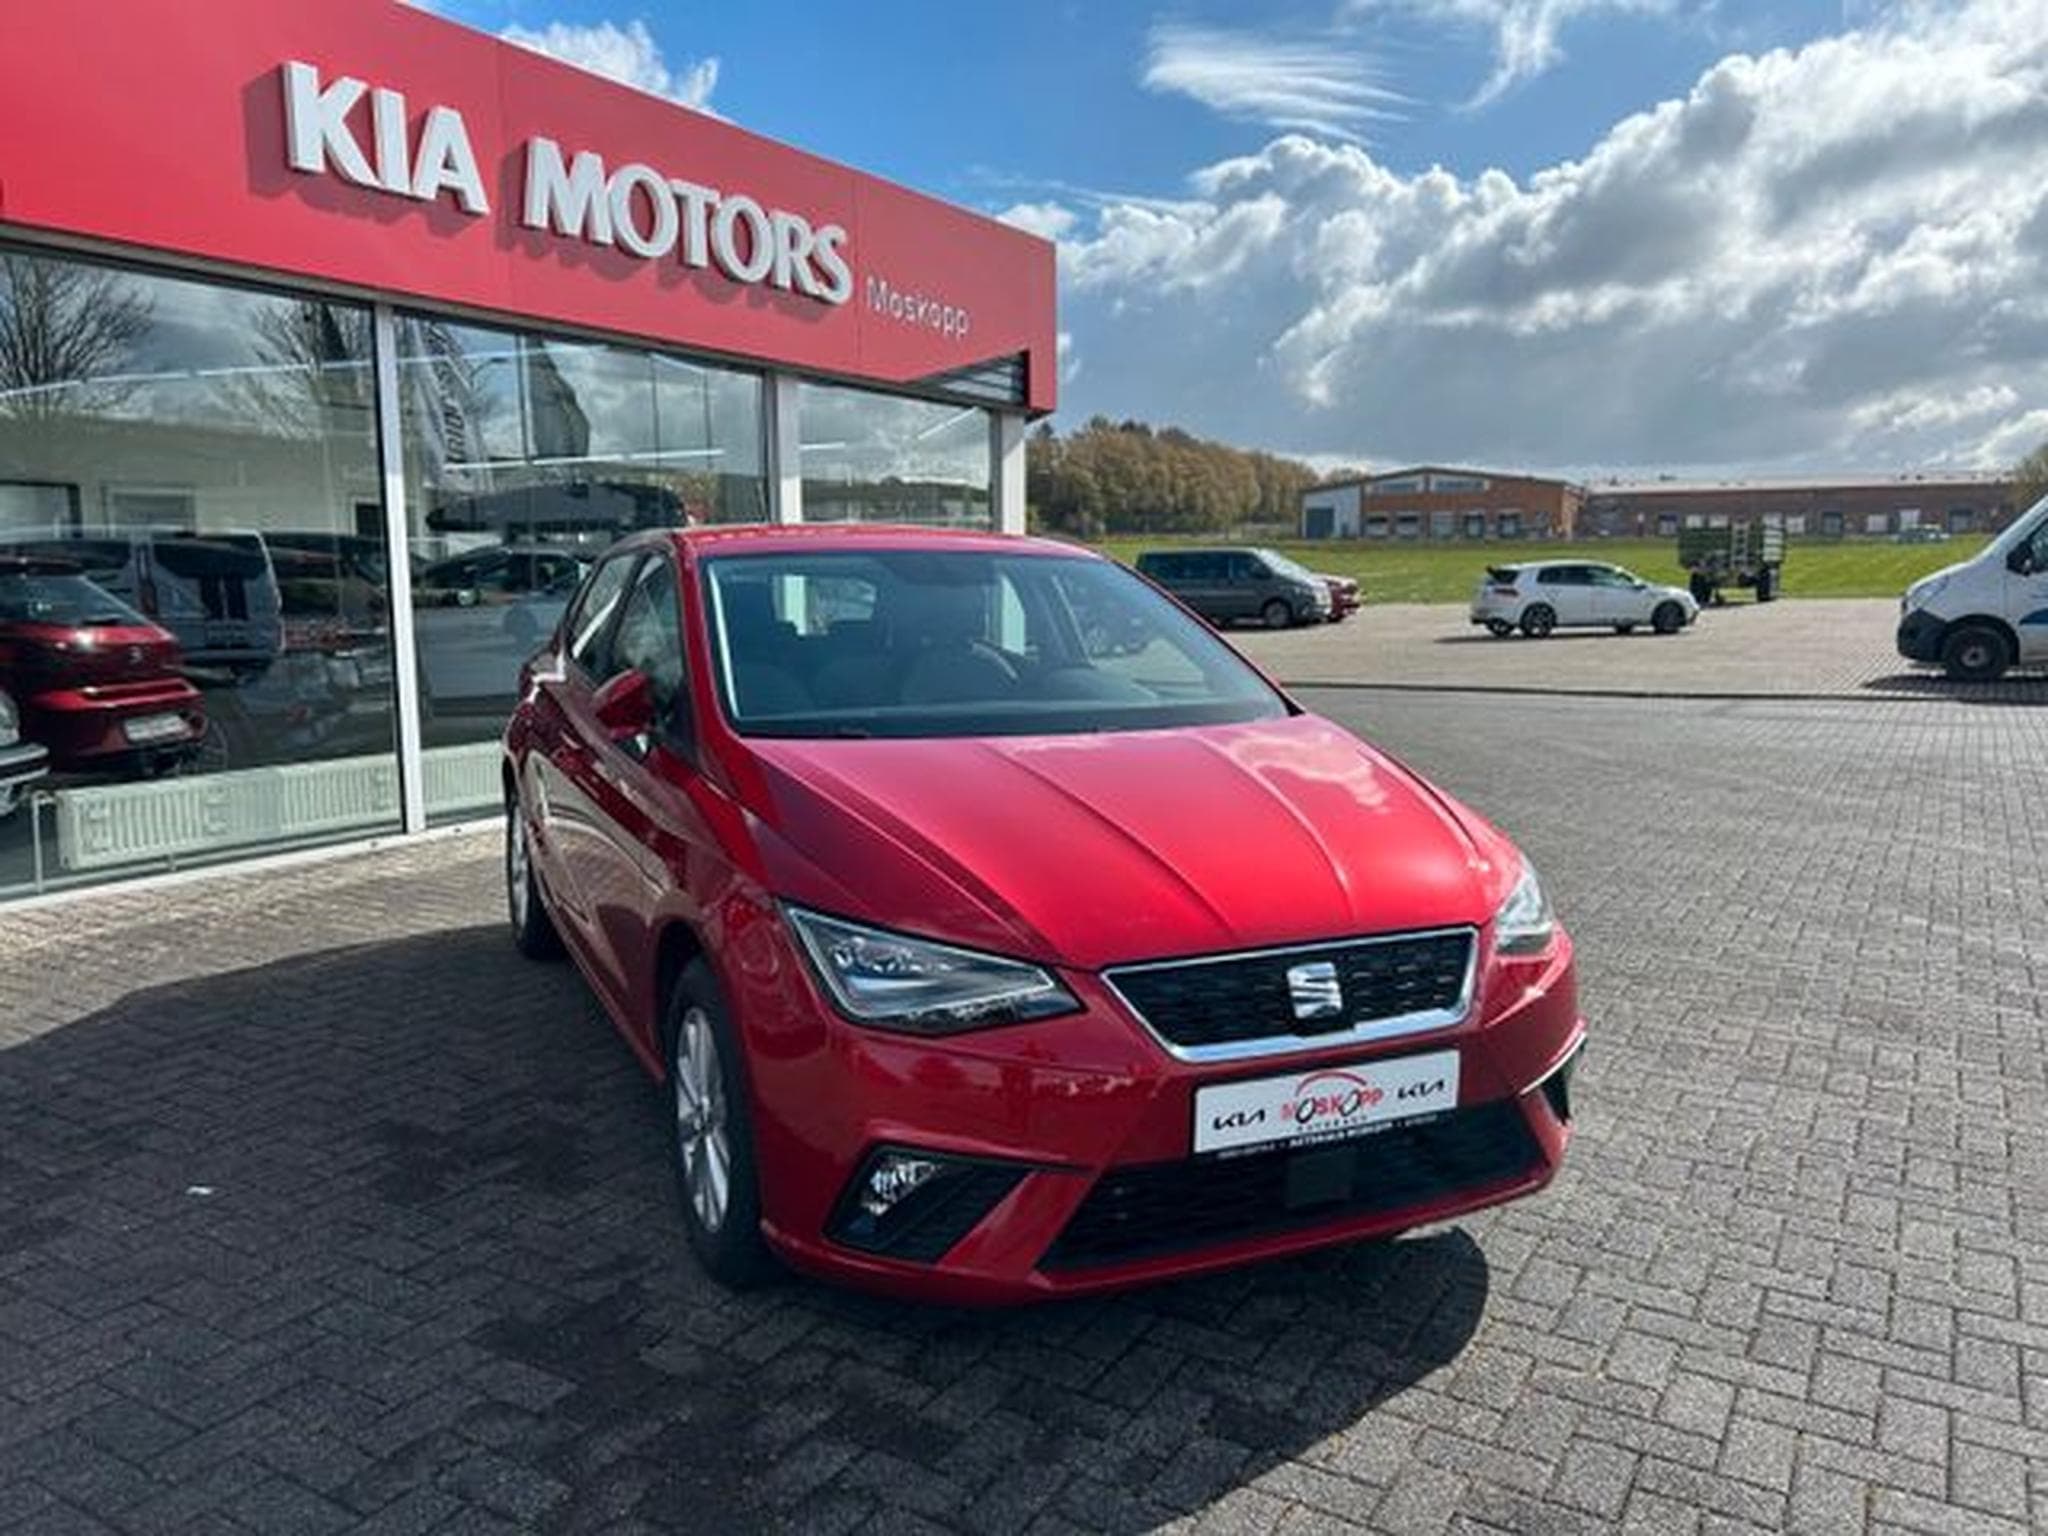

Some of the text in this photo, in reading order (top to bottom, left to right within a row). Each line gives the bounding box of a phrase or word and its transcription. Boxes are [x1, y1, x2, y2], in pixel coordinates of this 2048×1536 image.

[283, 61, 853, 304] KIA MOTORS
[867, 275, 971, 340] Moskopp
